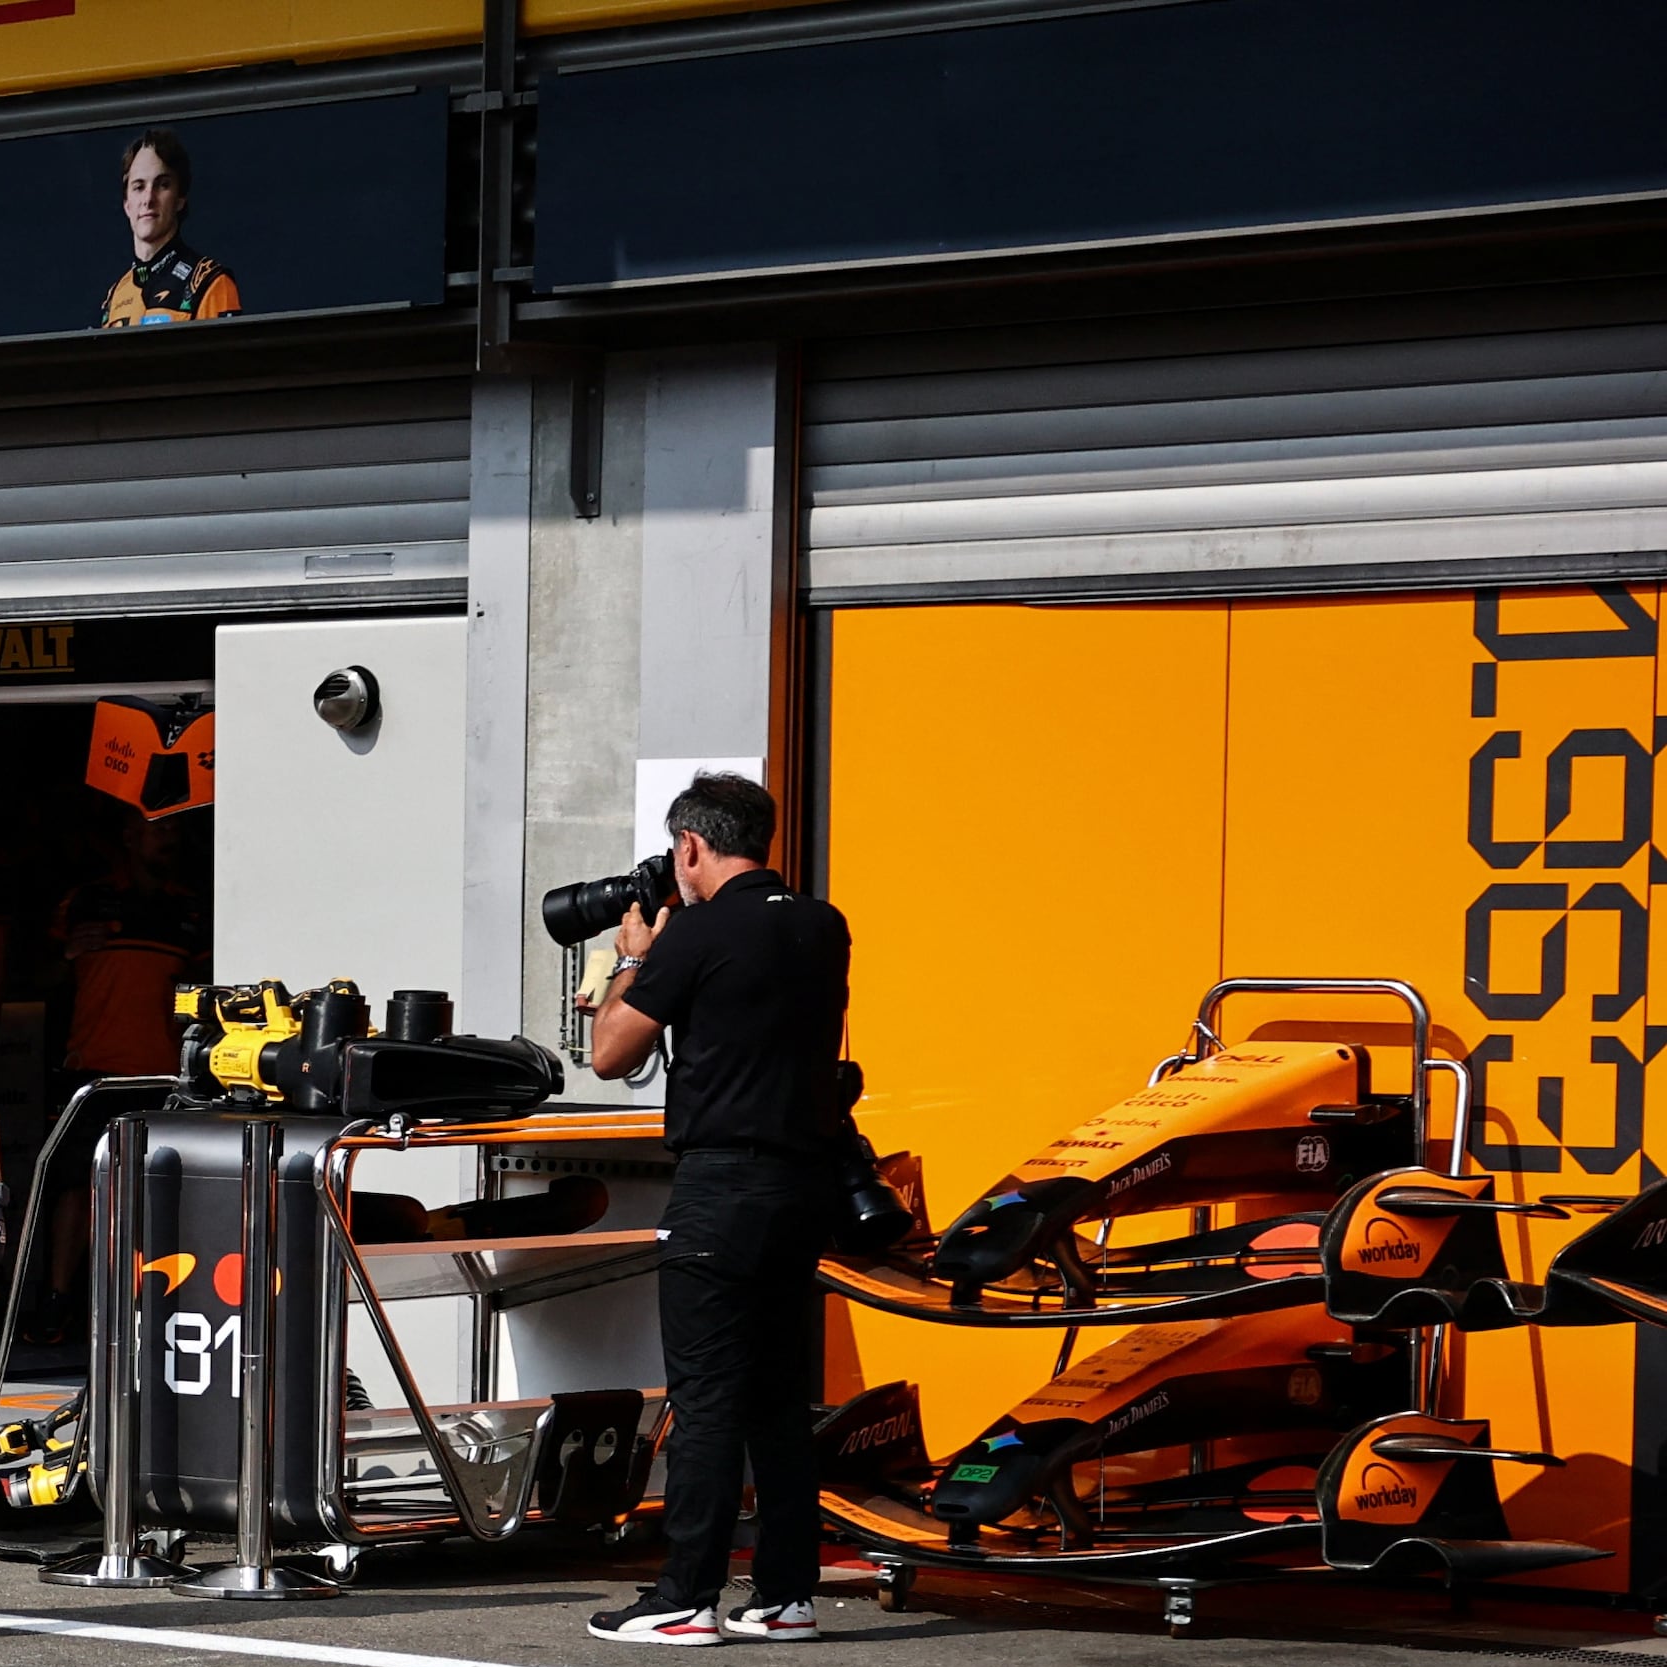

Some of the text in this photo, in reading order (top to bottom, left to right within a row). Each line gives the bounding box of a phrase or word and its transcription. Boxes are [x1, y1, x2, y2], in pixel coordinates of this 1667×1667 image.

[1124, 1100, 1189, 1108] CISCO
[1109, 1118, 1162, 1129] rubrik
[1106, 1152, 1172, 1199] JACK DANIEL'S
[1357, 1240, 1420, 1265] workday
[164, 1312, 241, 1398] 81
[1104, 1391, 1171, 1438] JACK DANIEL'S
[958, 1468, 992, 1480] OP2
[1355, 1484, 1417, 1511] workday
